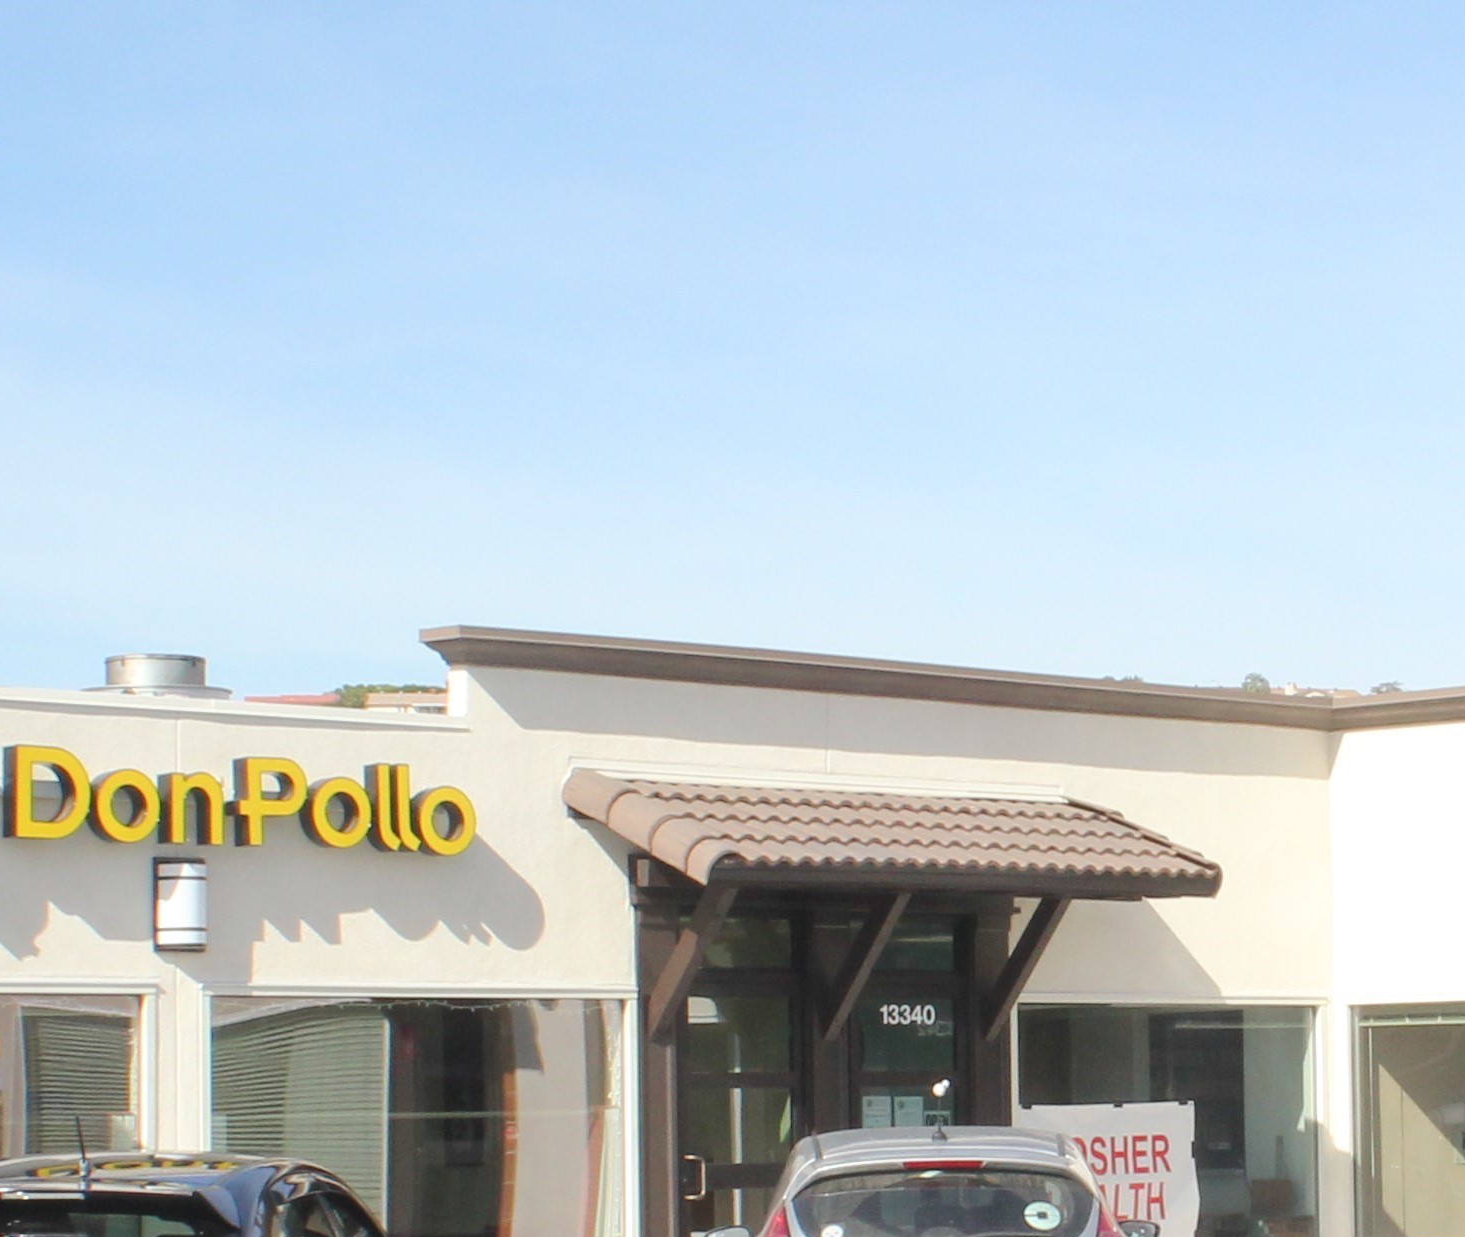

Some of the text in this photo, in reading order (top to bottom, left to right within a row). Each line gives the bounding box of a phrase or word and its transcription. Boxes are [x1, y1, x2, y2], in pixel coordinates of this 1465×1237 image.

[879, 1004, 936, 1025] 13340
[1072, 1134, 1171, 1176] SHER
[1098, 1181, 1166, 1221] LTH
